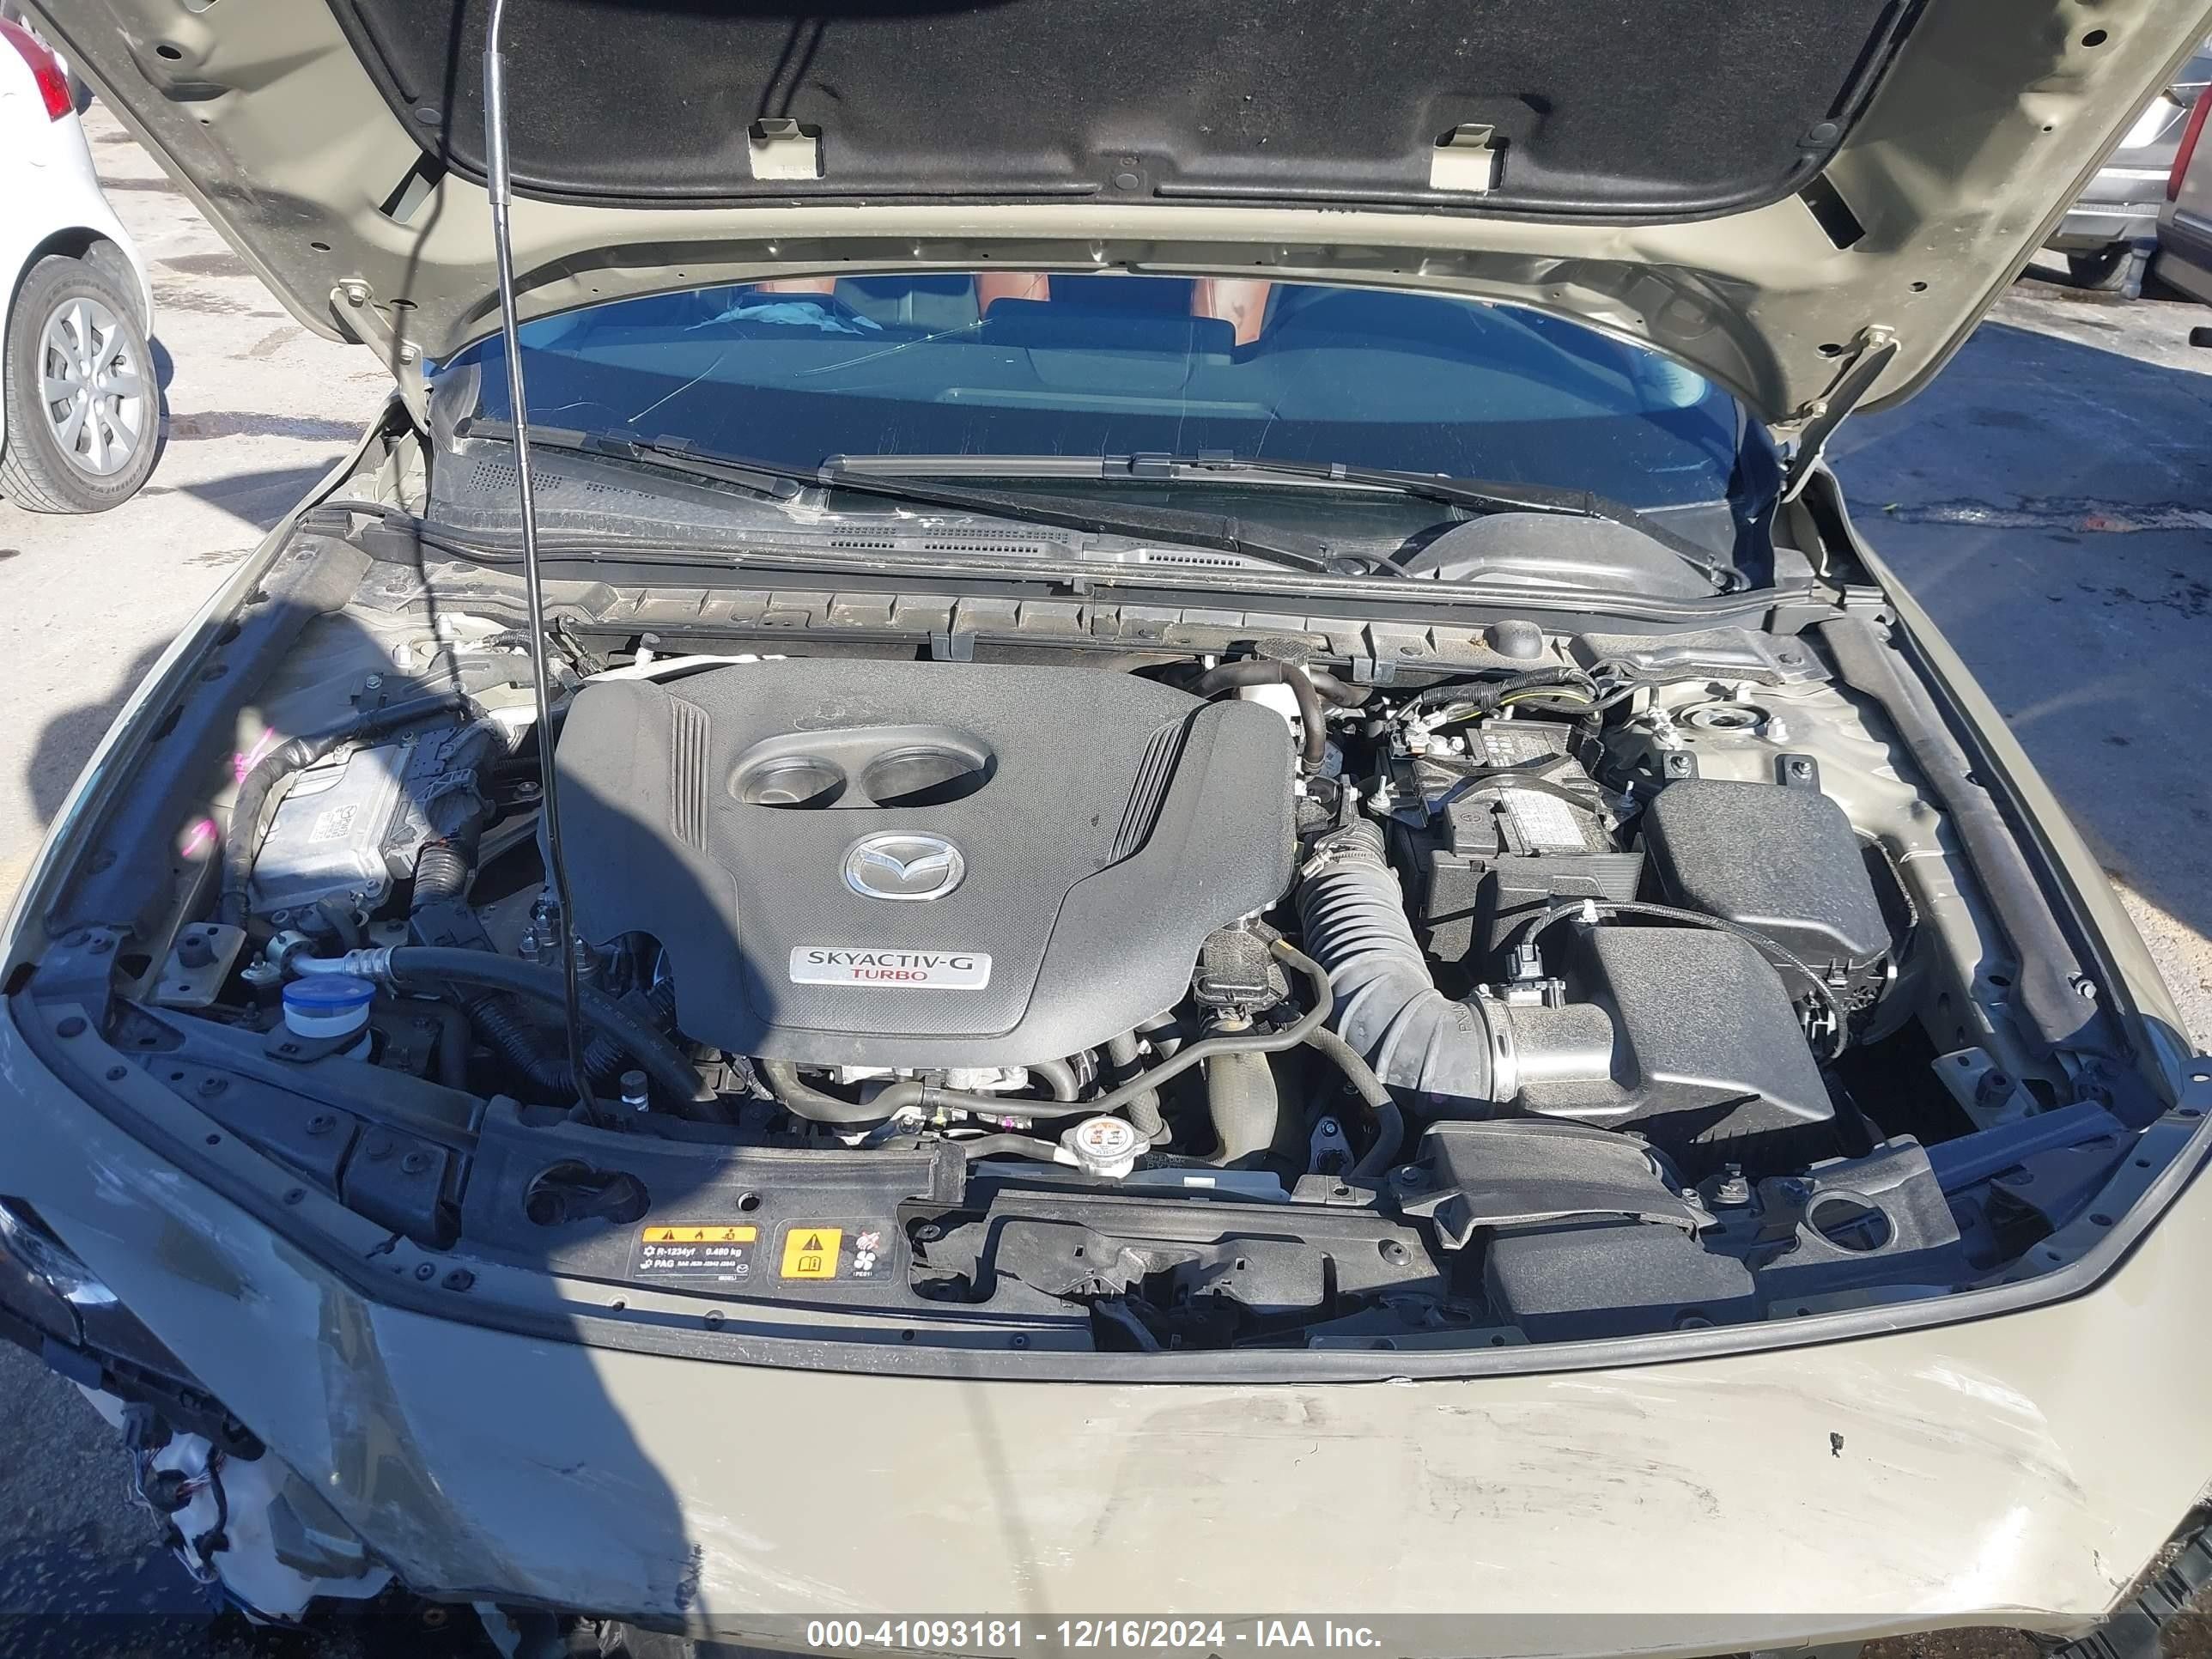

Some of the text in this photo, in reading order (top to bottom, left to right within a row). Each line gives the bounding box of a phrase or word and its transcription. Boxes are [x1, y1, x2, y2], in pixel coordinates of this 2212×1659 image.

[807, 951, 974, 970] SKYACTIV-G
[851, 969, 928, 981] TURBO
[657, 1248, 696, 1257] R-1234yf
[731, 1248, 742, 1257] kg
